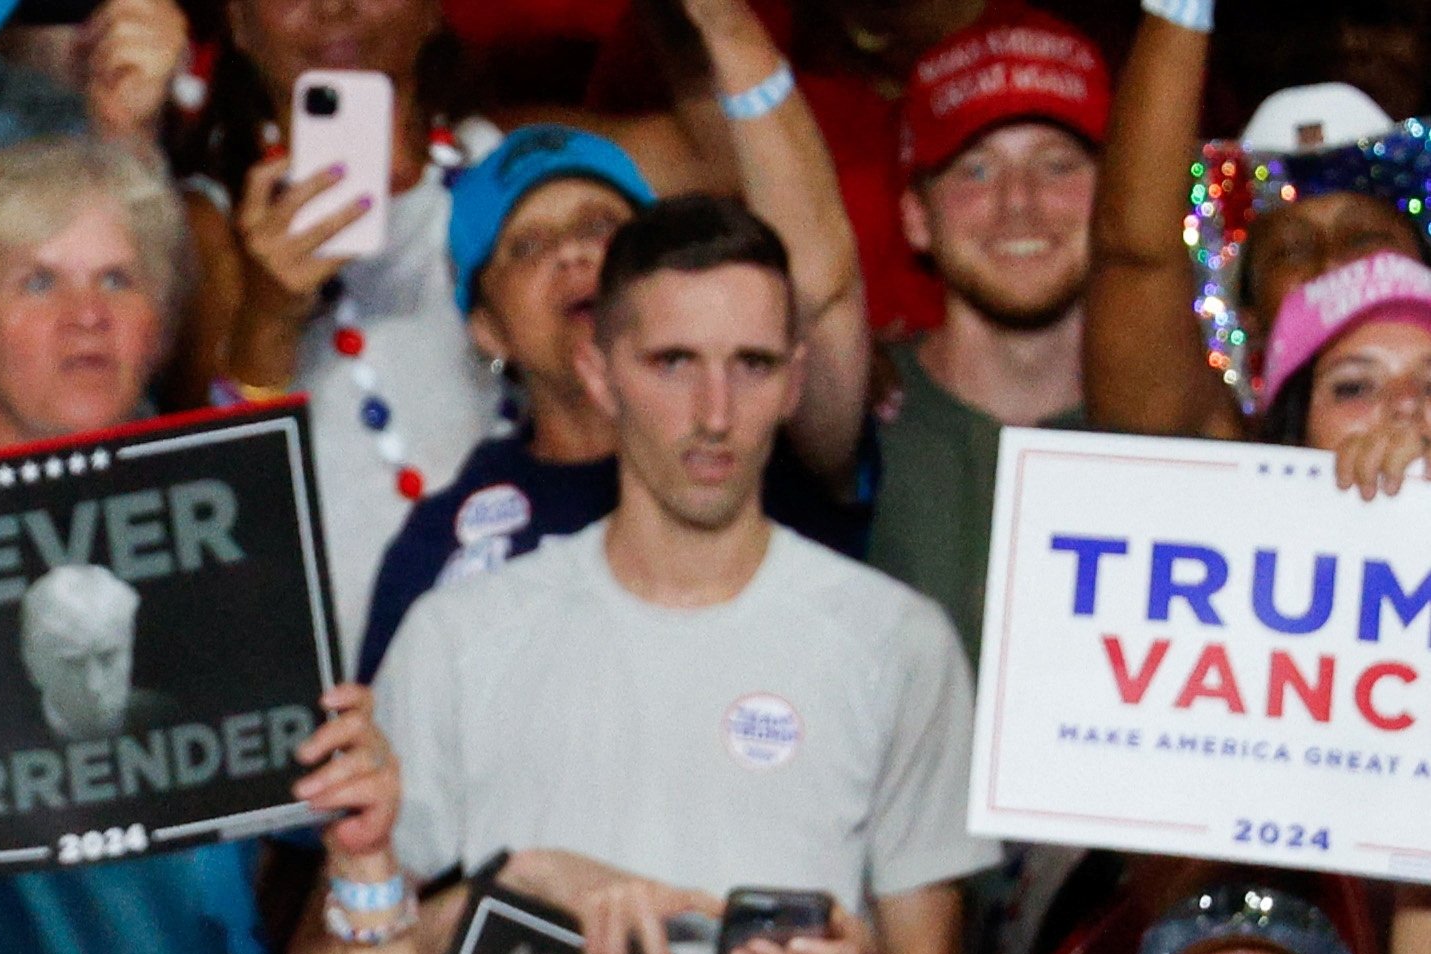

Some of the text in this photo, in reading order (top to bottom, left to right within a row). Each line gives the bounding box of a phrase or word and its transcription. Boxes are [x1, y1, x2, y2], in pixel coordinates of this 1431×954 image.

[1057, 723, 1143, 750] MAKE
[1155, 731, 1292, 764] AMERICA
[1302, 745, 1402, 776] GREAT
[57, 822, 148, 864] 2024
[1231, 817, 1334, 855] 2024
